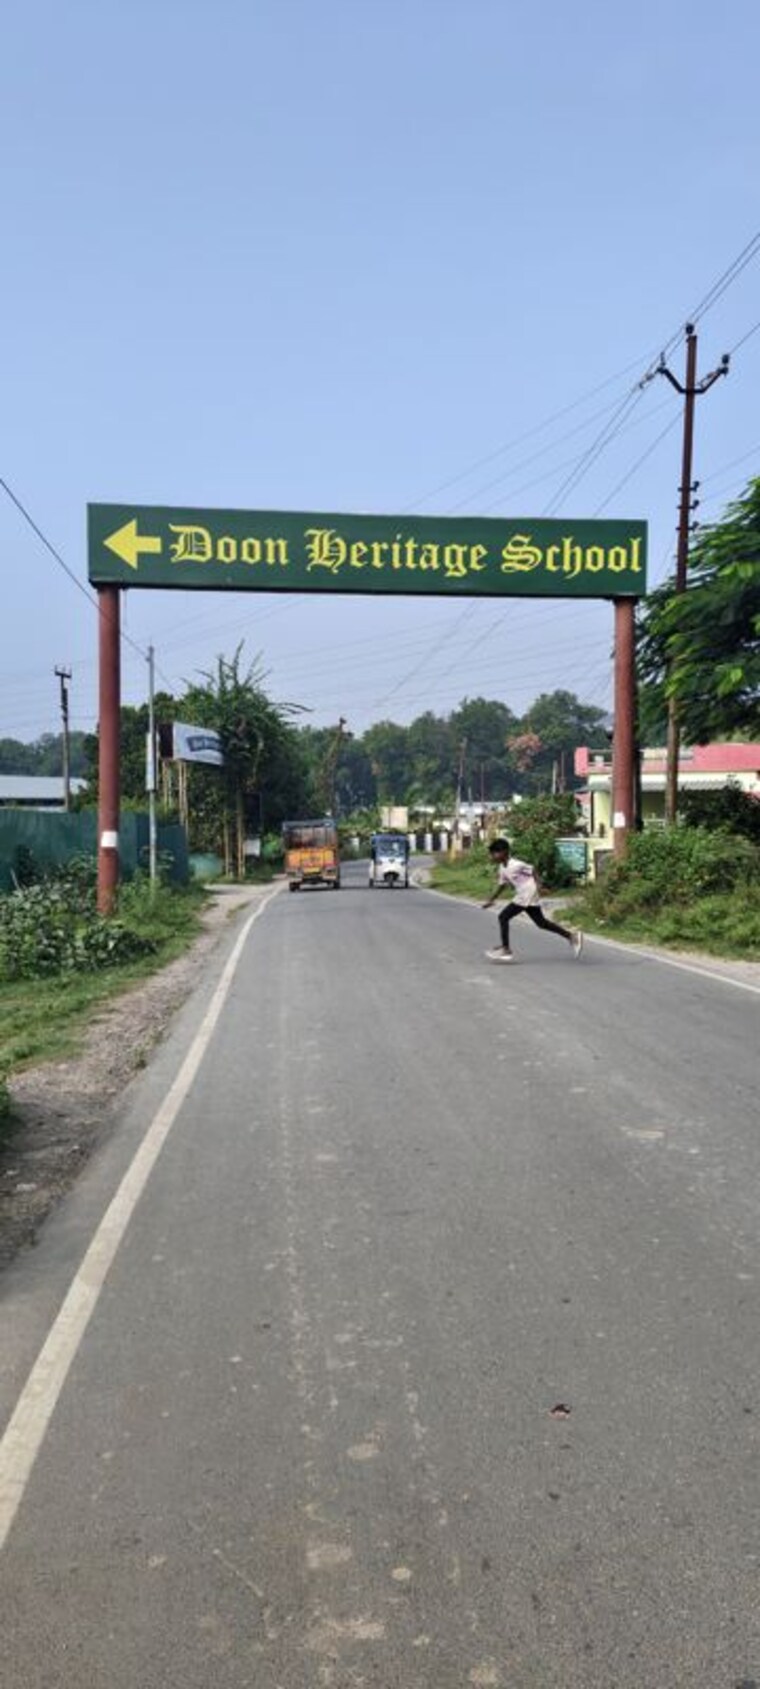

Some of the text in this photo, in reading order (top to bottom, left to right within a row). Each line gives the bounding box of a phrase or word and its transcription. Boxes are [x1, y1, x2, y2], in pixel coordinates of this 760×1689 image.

[168, 523, 642, 578] Doon Heritage School
